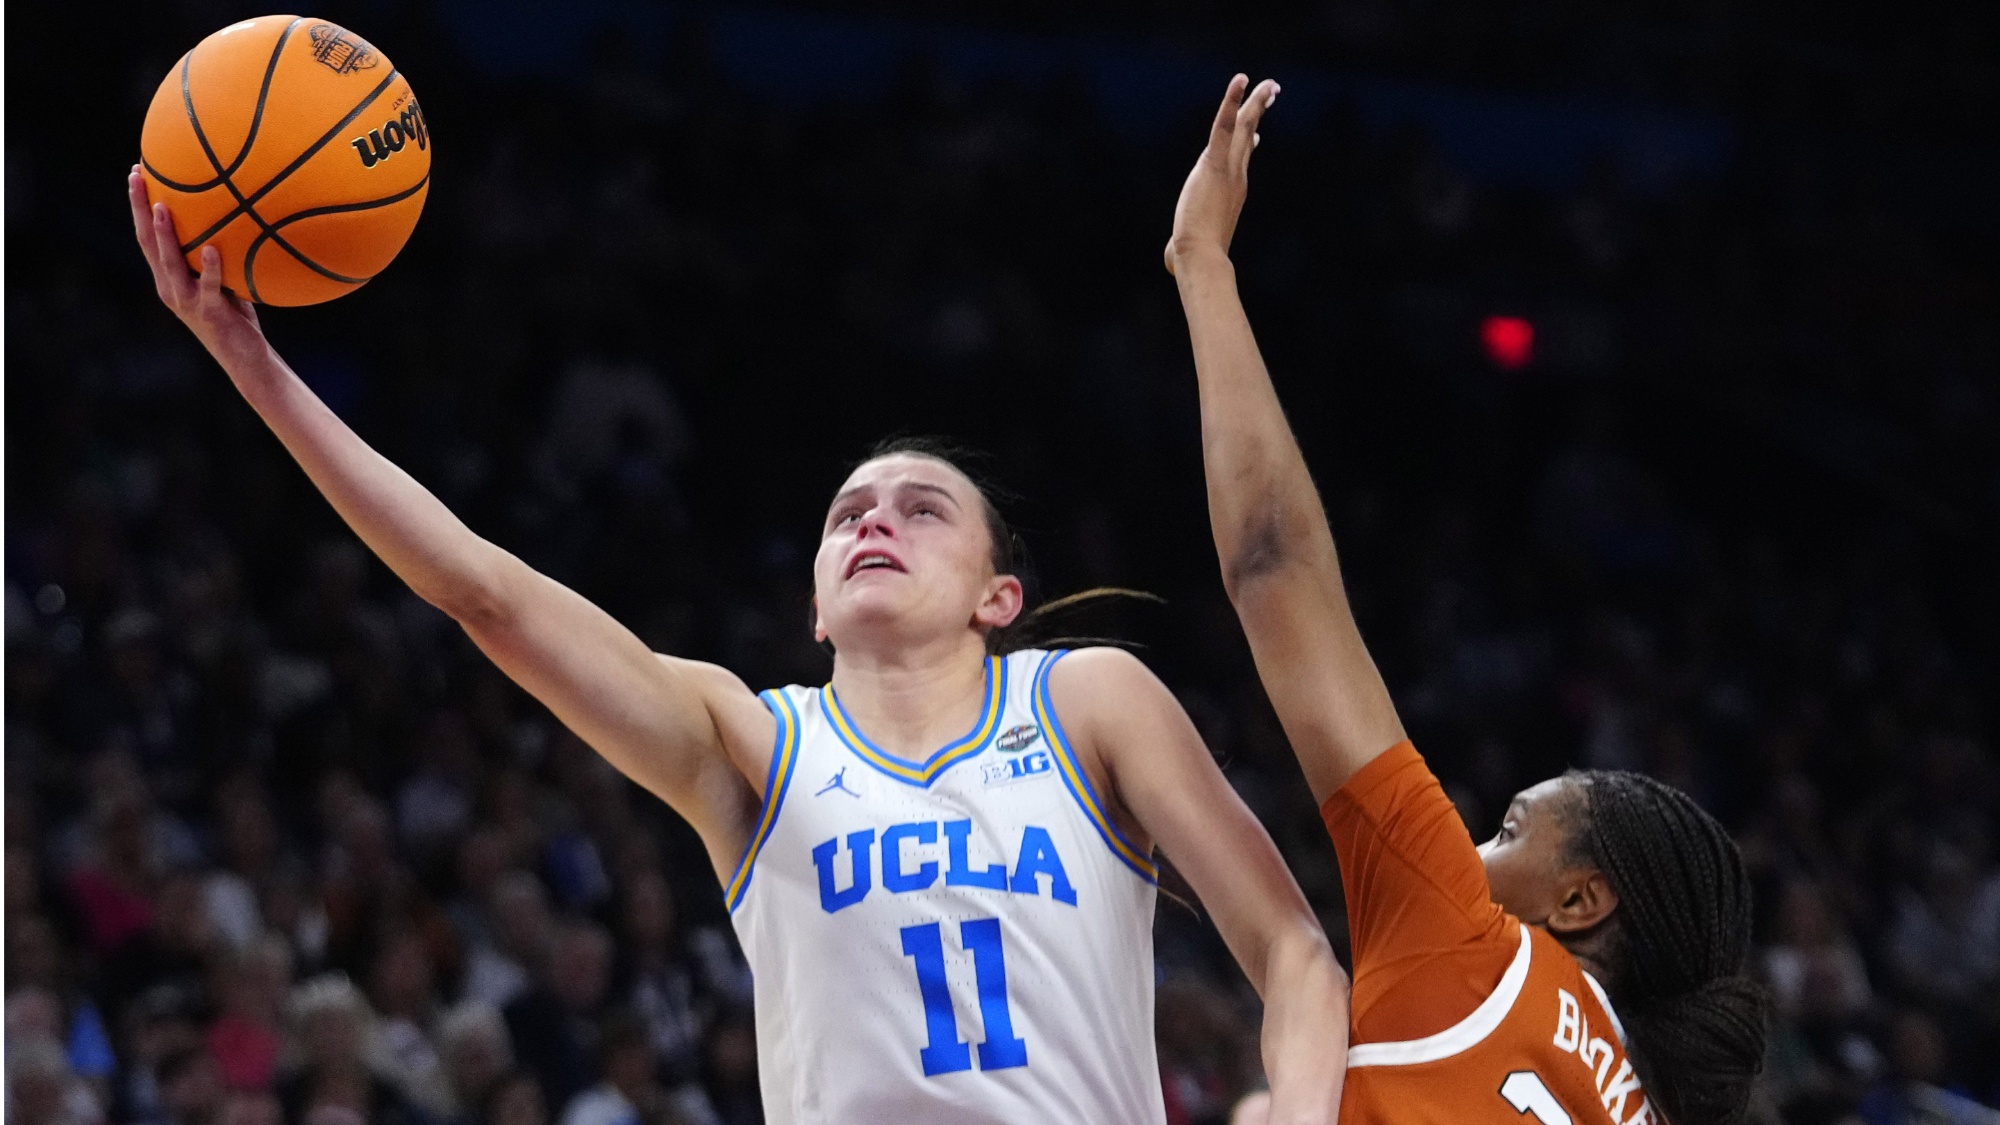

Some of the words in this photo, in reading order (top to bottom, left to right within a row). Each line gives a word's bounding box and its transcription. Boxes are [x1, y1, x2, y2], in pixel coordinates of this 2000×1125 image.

[351, 96, 429, 169] lson
[812, 818, 1078, 914] UCLA
[900, 917, 1028, 1077] 11
